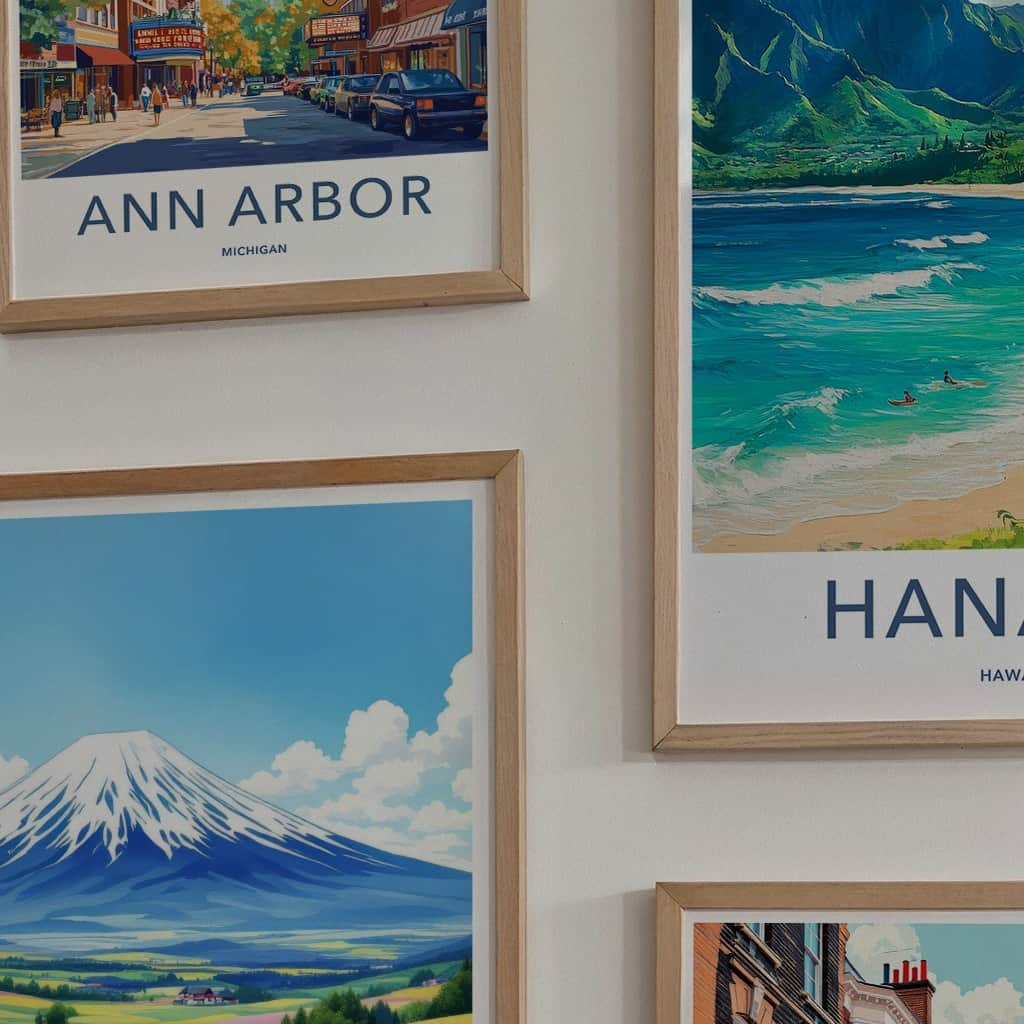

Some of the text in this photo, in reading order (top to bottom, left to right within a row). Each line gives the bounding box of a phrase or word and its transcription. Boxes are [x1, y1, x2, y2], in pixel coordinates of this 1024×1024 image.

[77, 175, 432, 236] ANN ARBOR
[221, 243, 288, 257] MICHIGAN
[826, 577, 1024, 639] HAN
